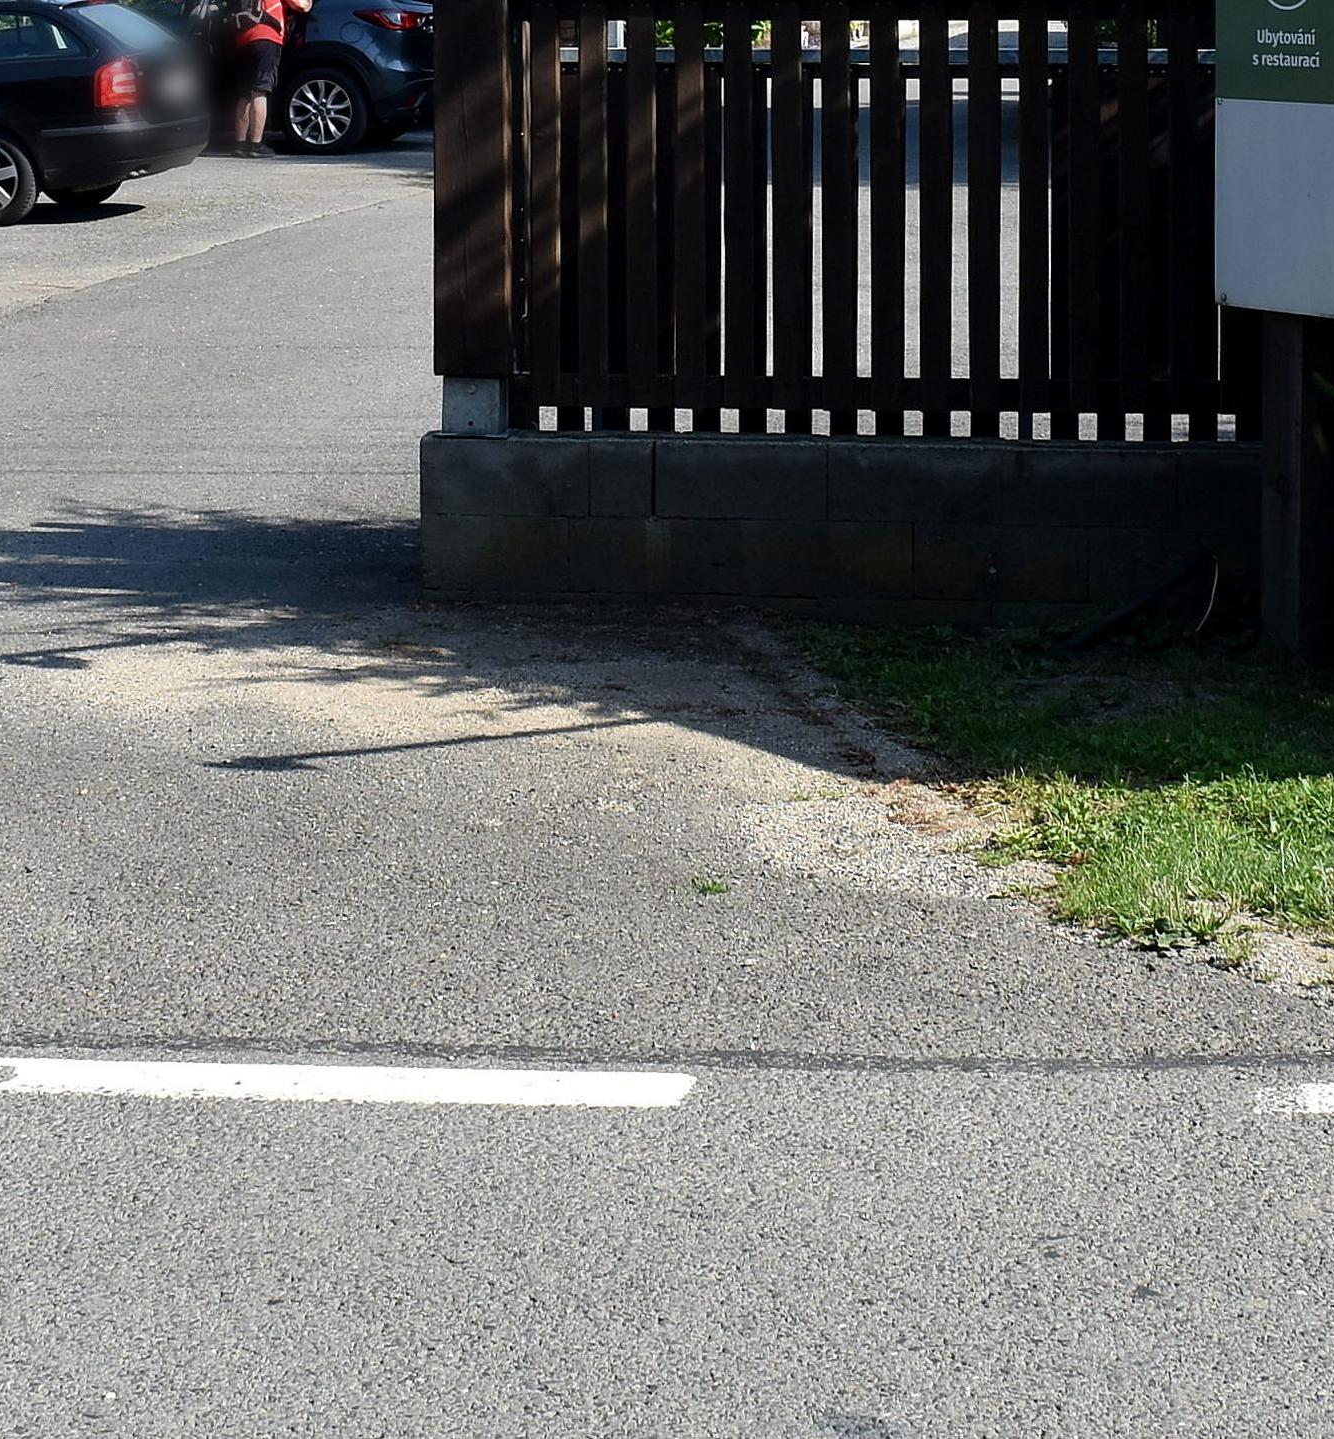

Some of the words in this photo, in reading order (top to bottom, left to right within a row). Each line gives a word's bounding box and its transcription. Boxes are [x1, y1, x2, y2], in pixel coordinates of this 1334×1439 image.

[1256, 28, 1316, 48] Ubytování
[1252, 54, 1259, 66] s
[1261, 51, 1320, 68] restaurací
